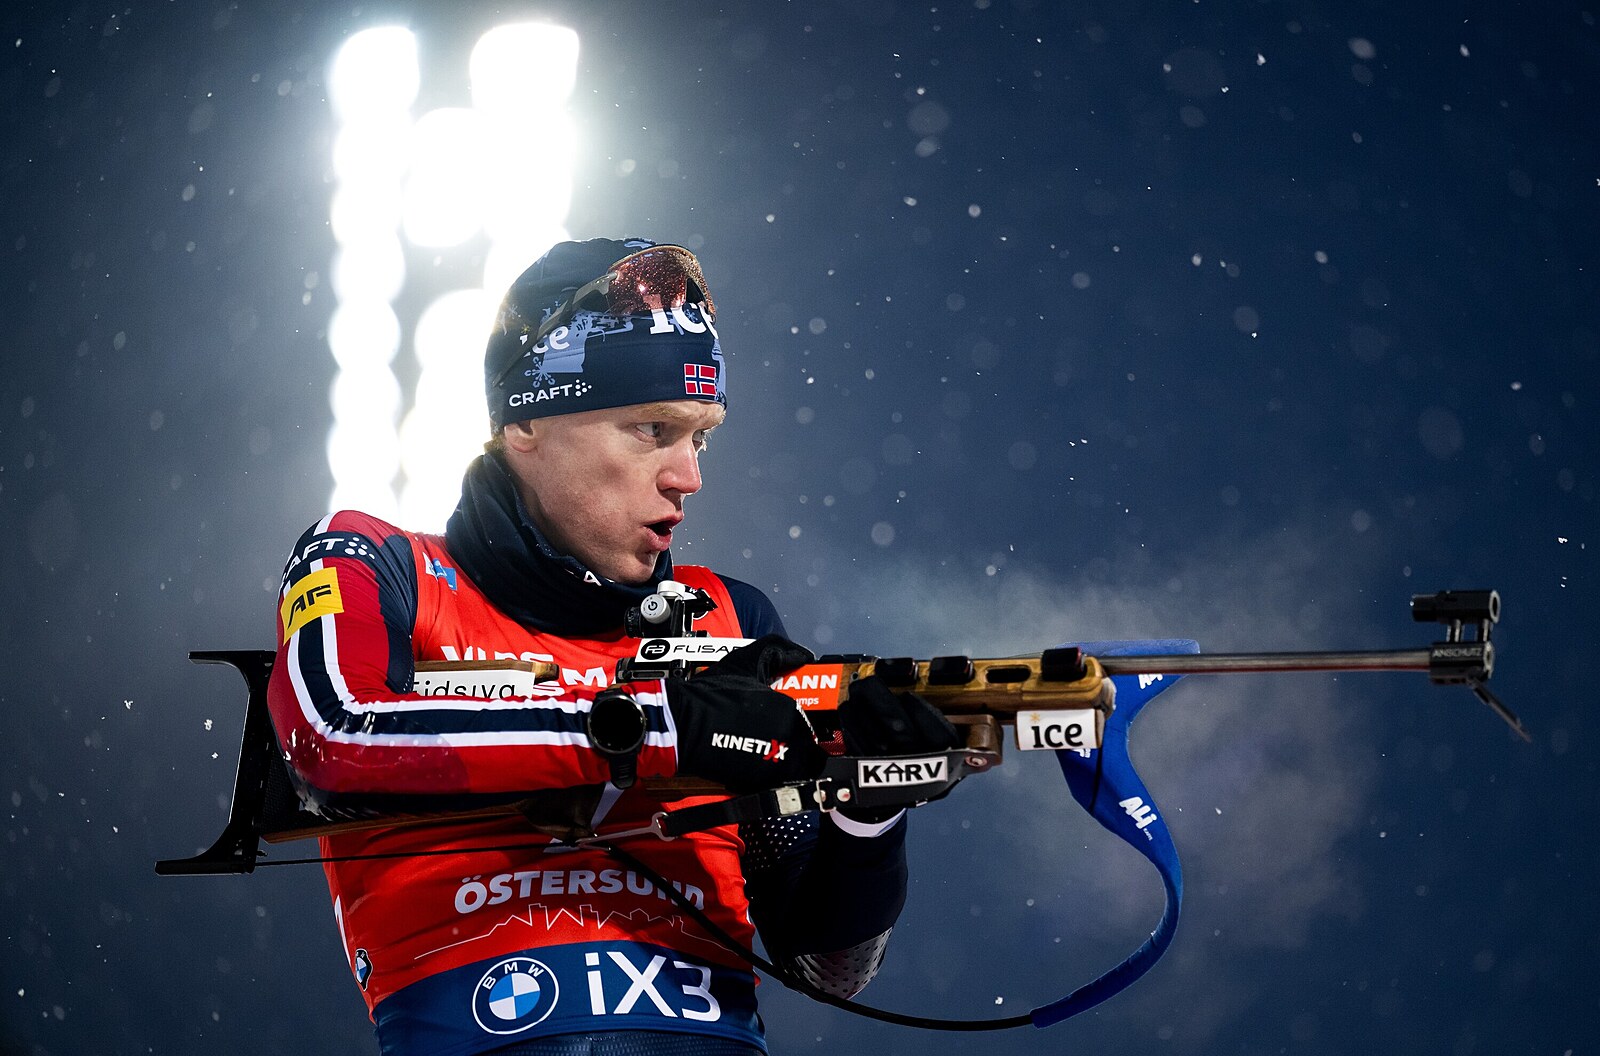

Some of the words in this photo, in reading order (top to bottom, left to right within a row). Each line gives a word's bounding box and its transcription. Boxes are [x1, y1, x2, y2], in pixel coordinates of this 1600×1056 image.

[509, 383, 573, 407] CRAFT
[281, 538, 345, 586] AFT
[673, 645, 740, 654] FLISA
[1031, 723, 1084, 748] ice
[584, 951, 721, 1022] iX3
